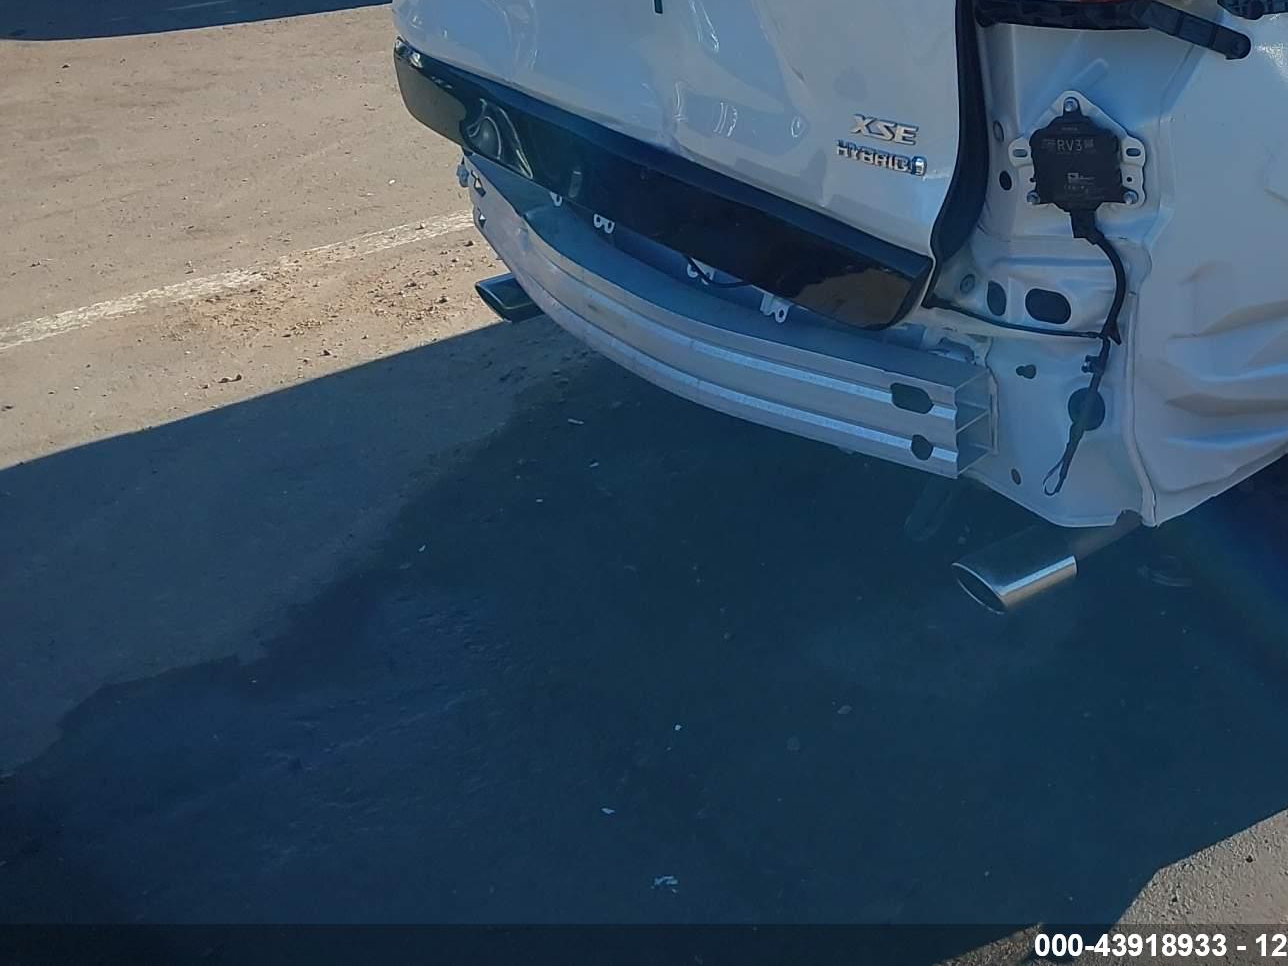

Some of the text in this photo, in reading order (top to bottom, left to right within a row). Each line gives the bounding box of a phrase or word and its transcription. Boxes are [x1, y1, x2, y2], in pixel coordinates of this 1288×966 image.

[850, 113, 919, 146] XSE
[1057, 139, 1083, 152] RV3
[836, 139, 912, 173] HYBRID
